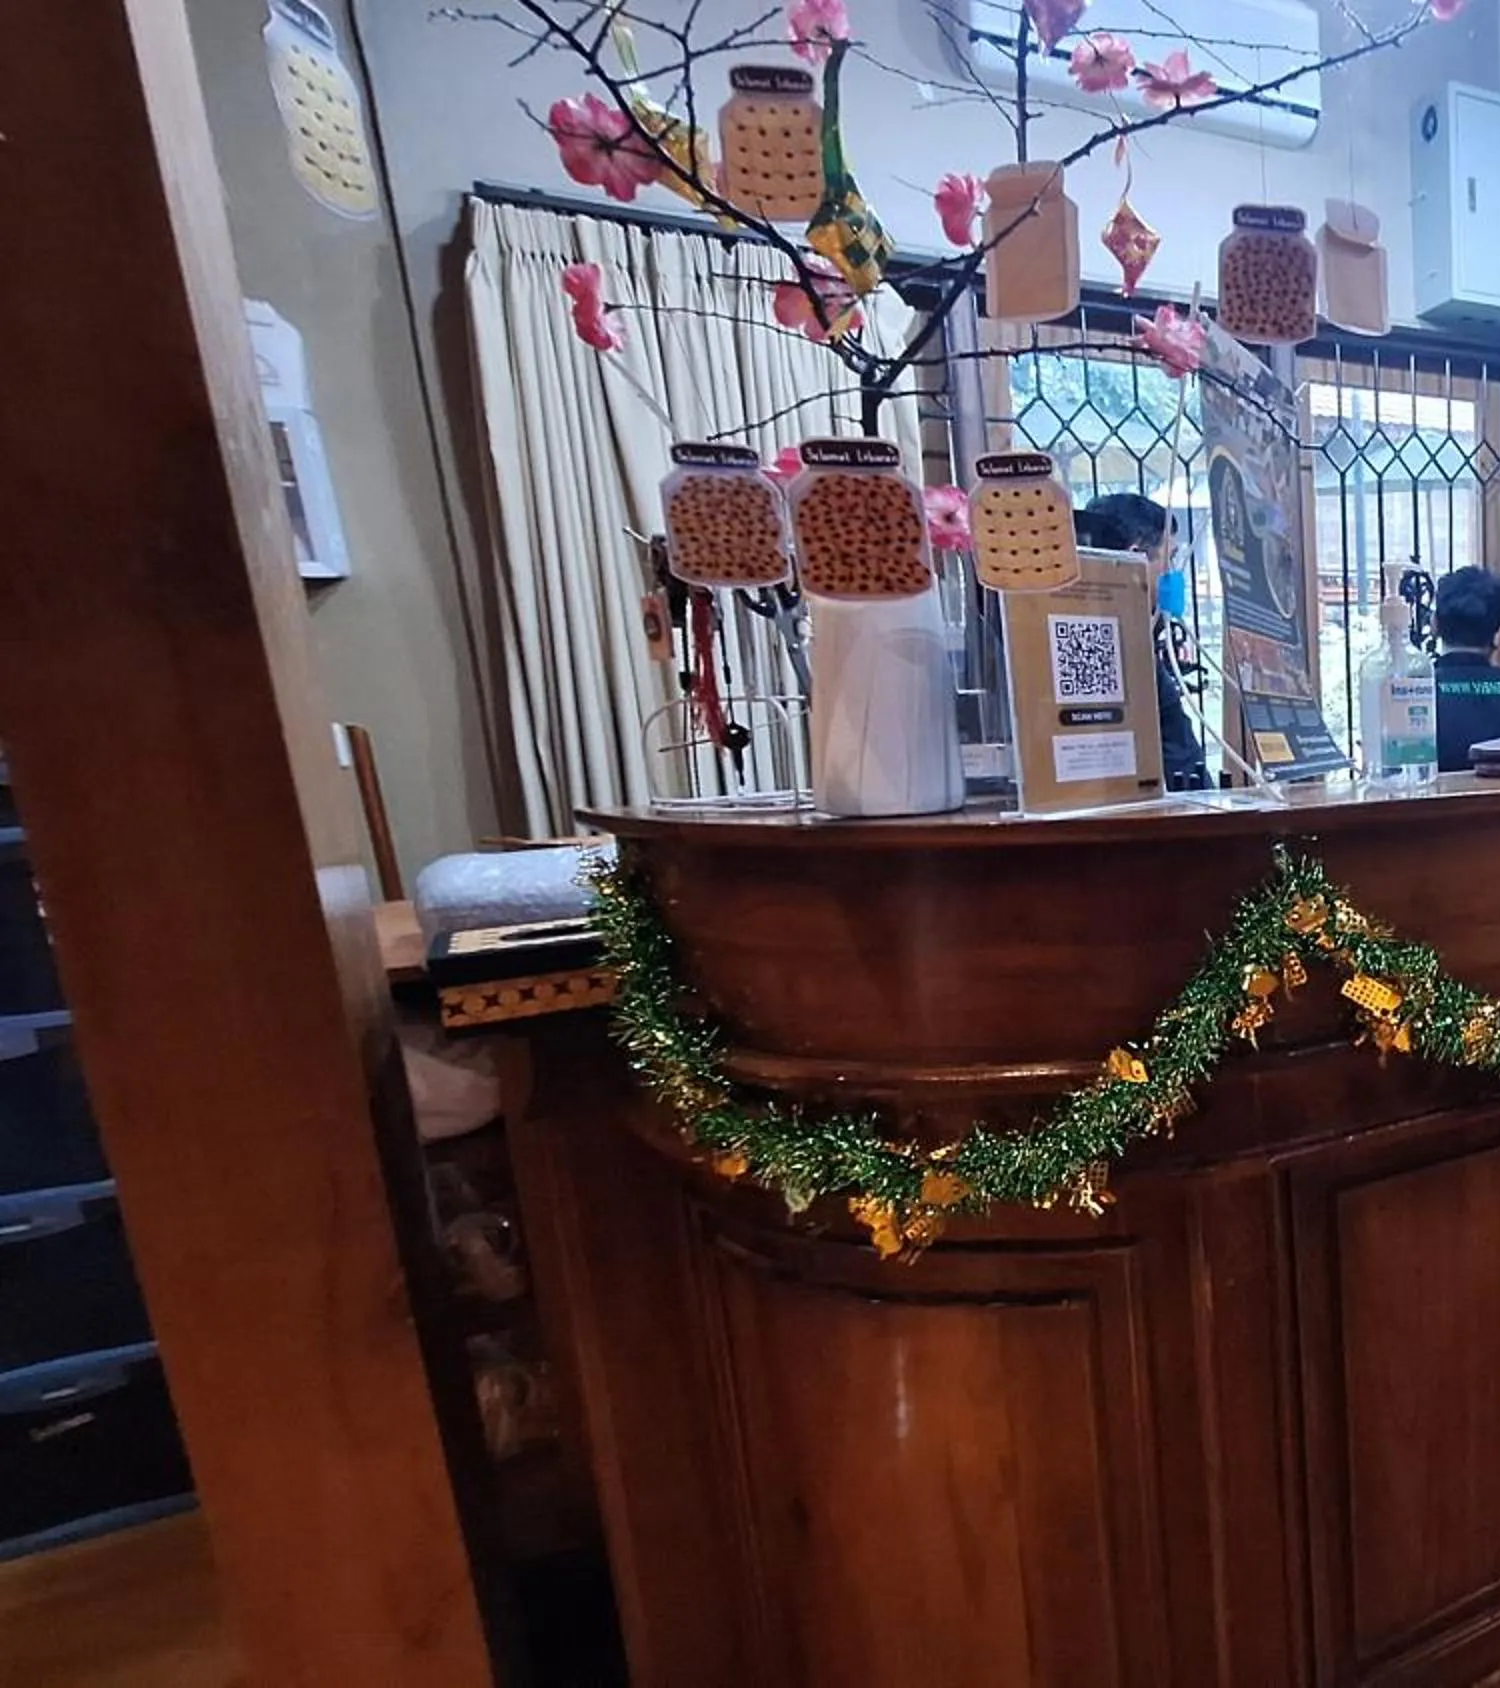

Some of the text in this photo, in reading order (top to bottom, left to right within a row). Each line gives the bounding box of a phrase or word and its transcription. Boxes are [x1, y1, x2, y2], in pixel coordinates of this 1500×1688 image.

[675, 447, 716, 464] Selamat
[805, 447, 851, 463] Selamat
[980, 462, 1014, 475] Selamat
